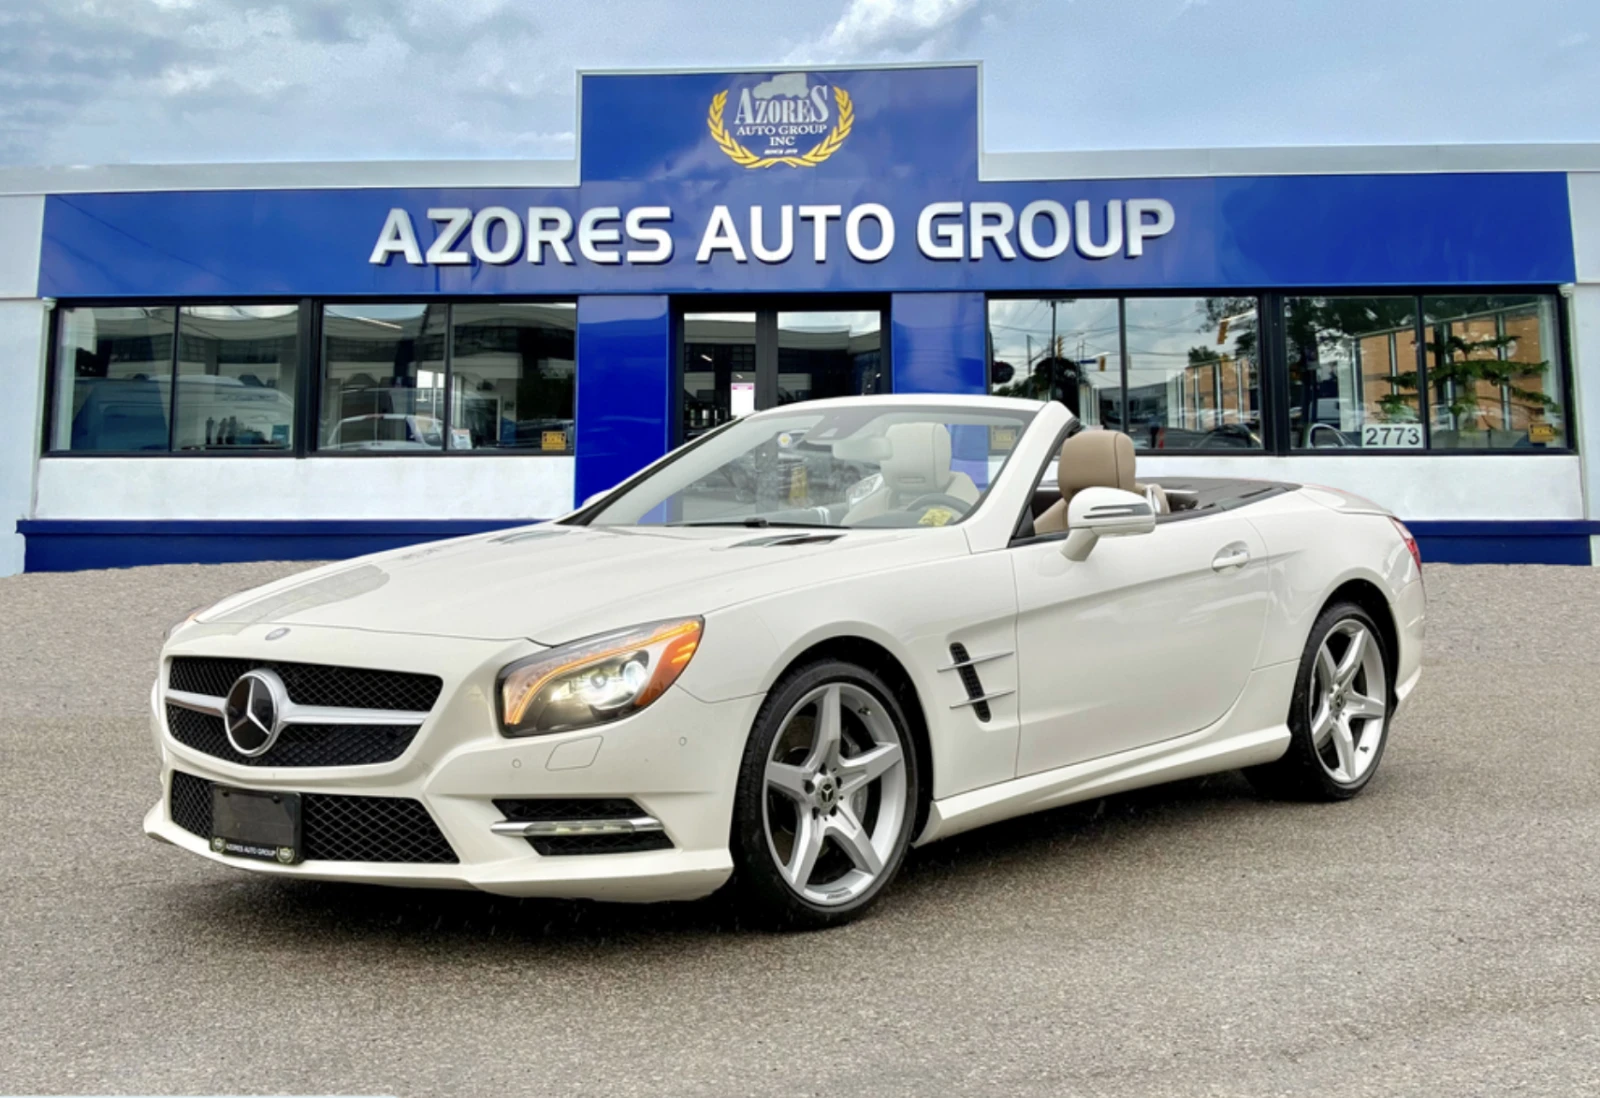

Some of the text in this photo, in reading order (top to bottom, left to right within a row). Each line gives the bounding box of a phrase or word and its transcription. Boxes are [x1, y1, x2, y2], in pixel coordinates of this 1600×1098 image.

[734, 85, 829, 124] AZORES
[736, 124, 828, 136] AUTO GROUP
[769, 136, 796, 146] INC
[369, 199, 1176, 265] AZORES AUTO GROUP
[1365, 427, 1421, 446] 2773
